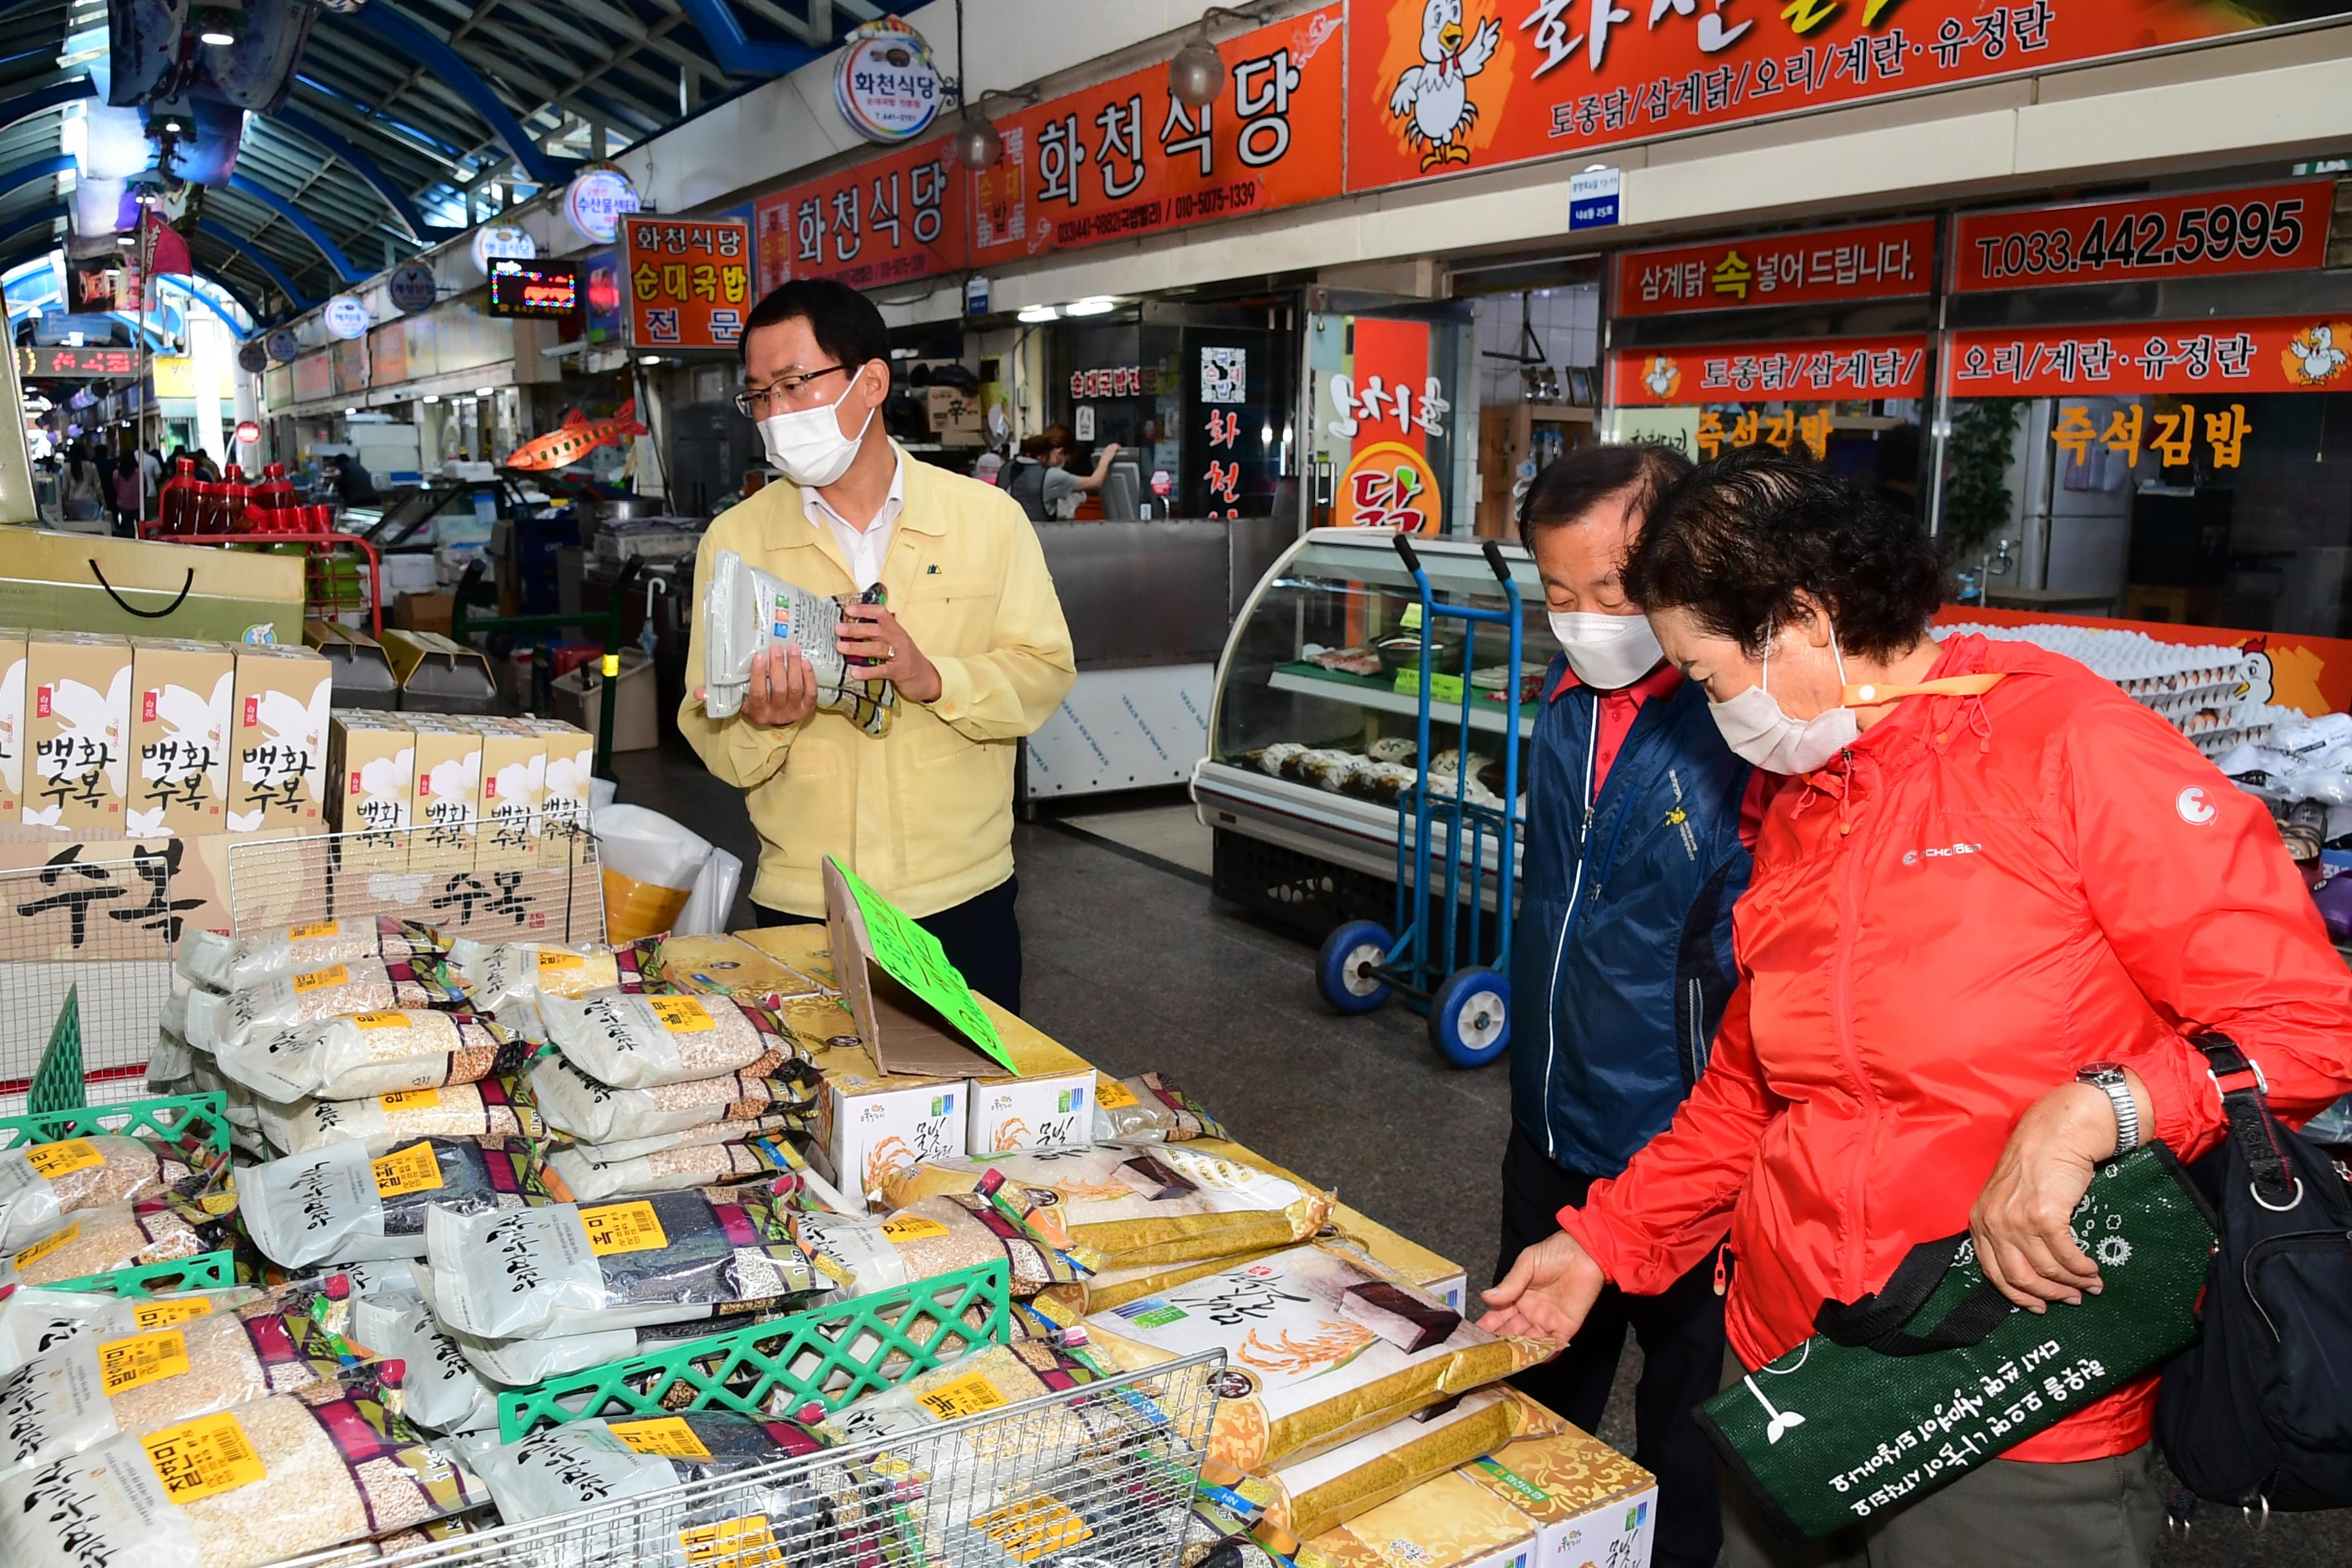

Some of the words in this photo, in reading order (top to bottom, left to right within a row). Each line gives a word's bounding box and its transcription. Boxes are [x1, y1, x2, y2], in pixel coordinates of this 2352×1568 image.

[855, 72, 935, 99] 화천식당
[1037, 47, 1300, 206] 화천식당
[797, 159, 946, 264] 화천식당
[636, 226, 741, 257] 화천식당
[632, 262, 748, 304] 순대국밥
[1640, 261, 1707, 302] 삼계닭
[1711, 250, 1752, 300] 속
[1756, 249, 1804, 293] 넣어
[1808, 239, 1915, 285] 드립니다.
[645, 308, 681, 343] 전
[2050, 403, 2253, 469] 즉석김밥
[39, 694, 50, 714] 白花
[145, 700, 155, 718] 白花
[246, 705, 256, 723] 白花
[36, 736, 117, 770] 백화
[141, 740, 219, 774] 백화
[242, 745, 317, 778] 백화
[40, 770, 108, 810] 수복
[144, 773, 210, 811] 수복
[244, 777, 307, 814] 수복
[542, 798, 582, 819] 백화
[357, 801, 403, 825] 백화
[425, 802, 471, 826] 백화
[491, 805, 533, 827] 백화
[16, 838, 206, 949] 수복
[429, 872, 536, 926] 수복
[651, 1000, 684, 1027] 율무
[590, 1214, 614, 1246] 흑미
[2019, 1337, 2063, 1371] 다시
[1979, 1360, 2021, 1397] 쓰면
[2044, 1357, 2107, 1403] 헌옷을
[1918, 1388, 1985, 1442] 생명이
[1988, 1391, 2043, 1437] 모으면
[152, 1436, 204, 1494] 찰현미
[1828, 1429, 1917, 1494] 되살아나요
[1924, 1429, 1990, 1478] 나눔이
[1849, 1470, 1922, 1518] 시작되요
